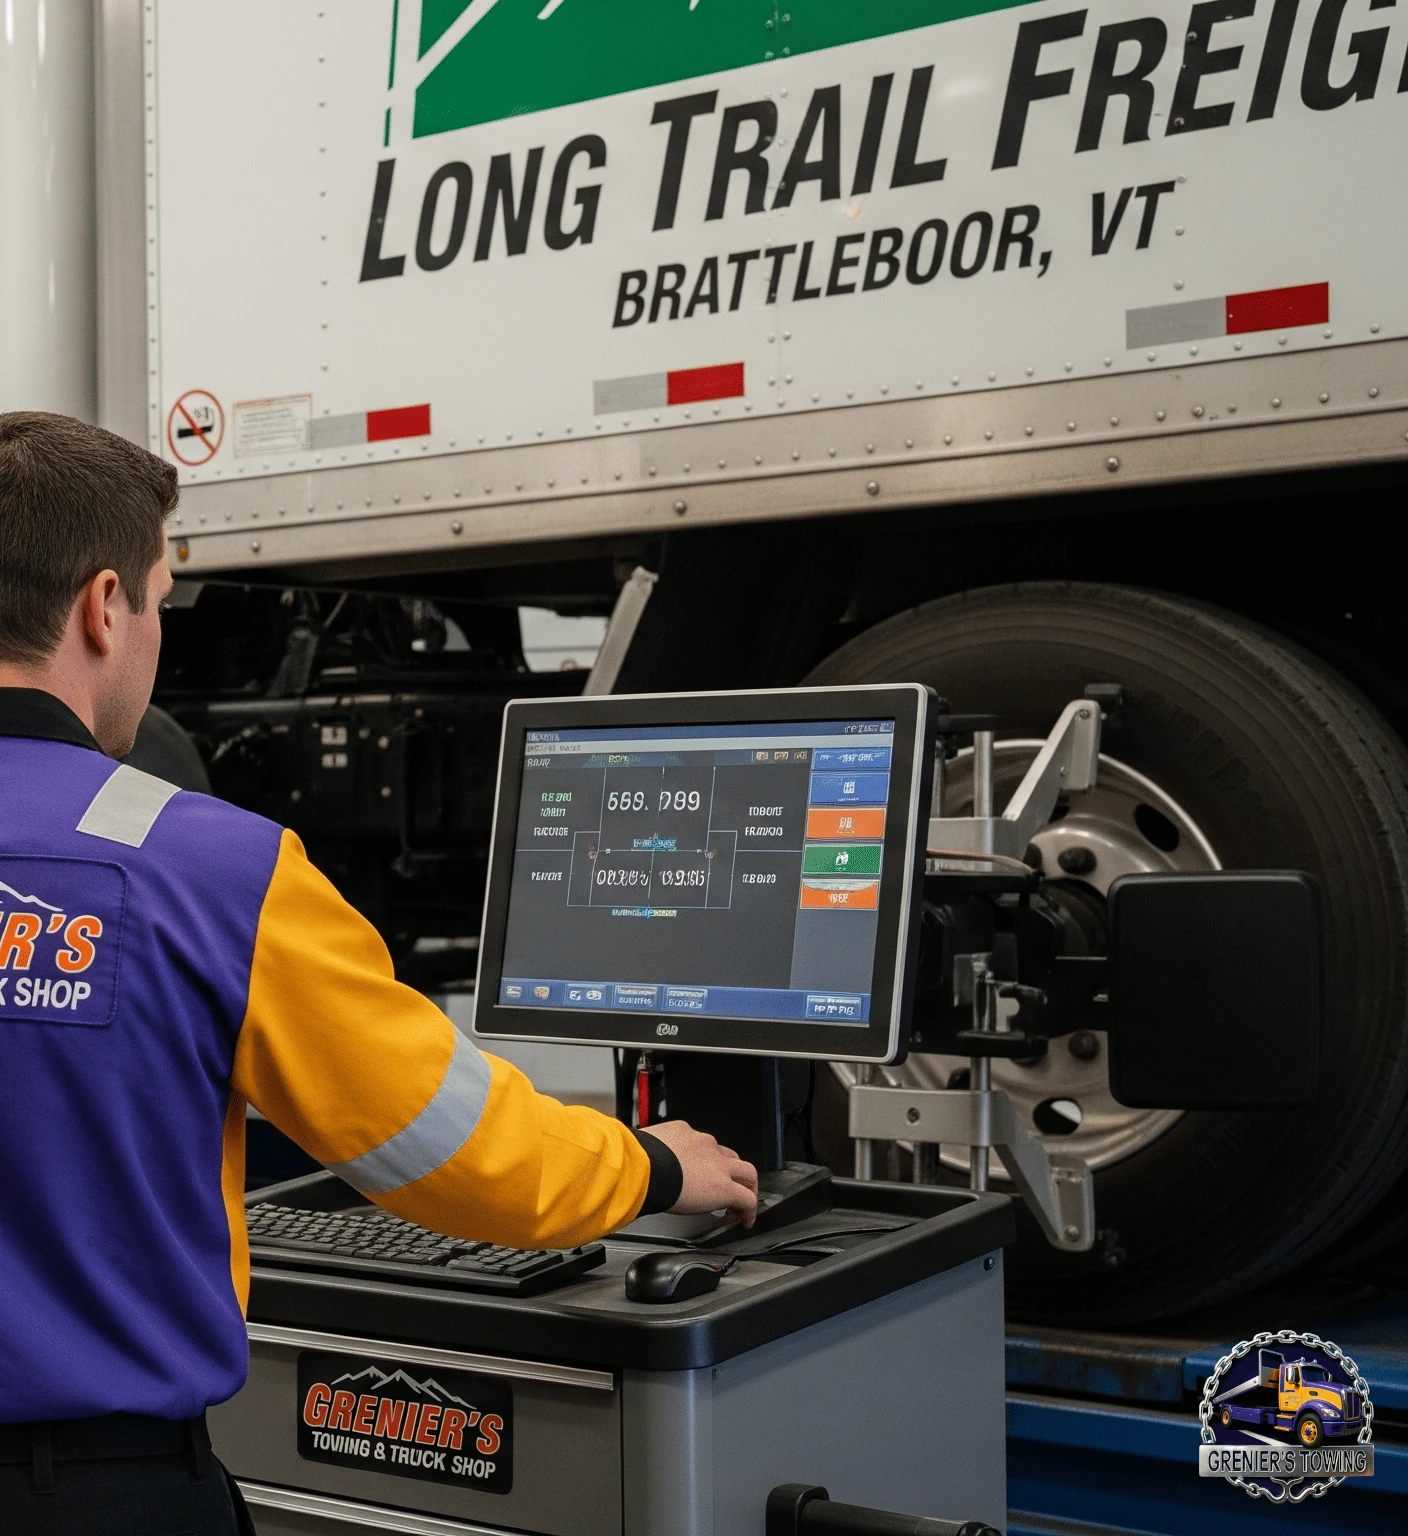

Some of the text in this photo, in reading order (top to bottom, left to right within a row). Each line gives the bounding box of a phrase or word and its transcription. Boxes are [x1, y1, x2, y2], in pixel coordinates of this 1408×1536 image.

[358, 0, 1408, 284] LONG TRAIL FREIG
[612, 180, 1176, 329] BRATTLEBOOR, VT
[13, 977, 91, 1011] SHOP
[303, 1382, 504, 1455] GRENIER'S
[373, 1441, 386, 1461] &
[390, 1444, 446, 1471] TRUCK
[451, 1455, 496, 1479] SHOP
